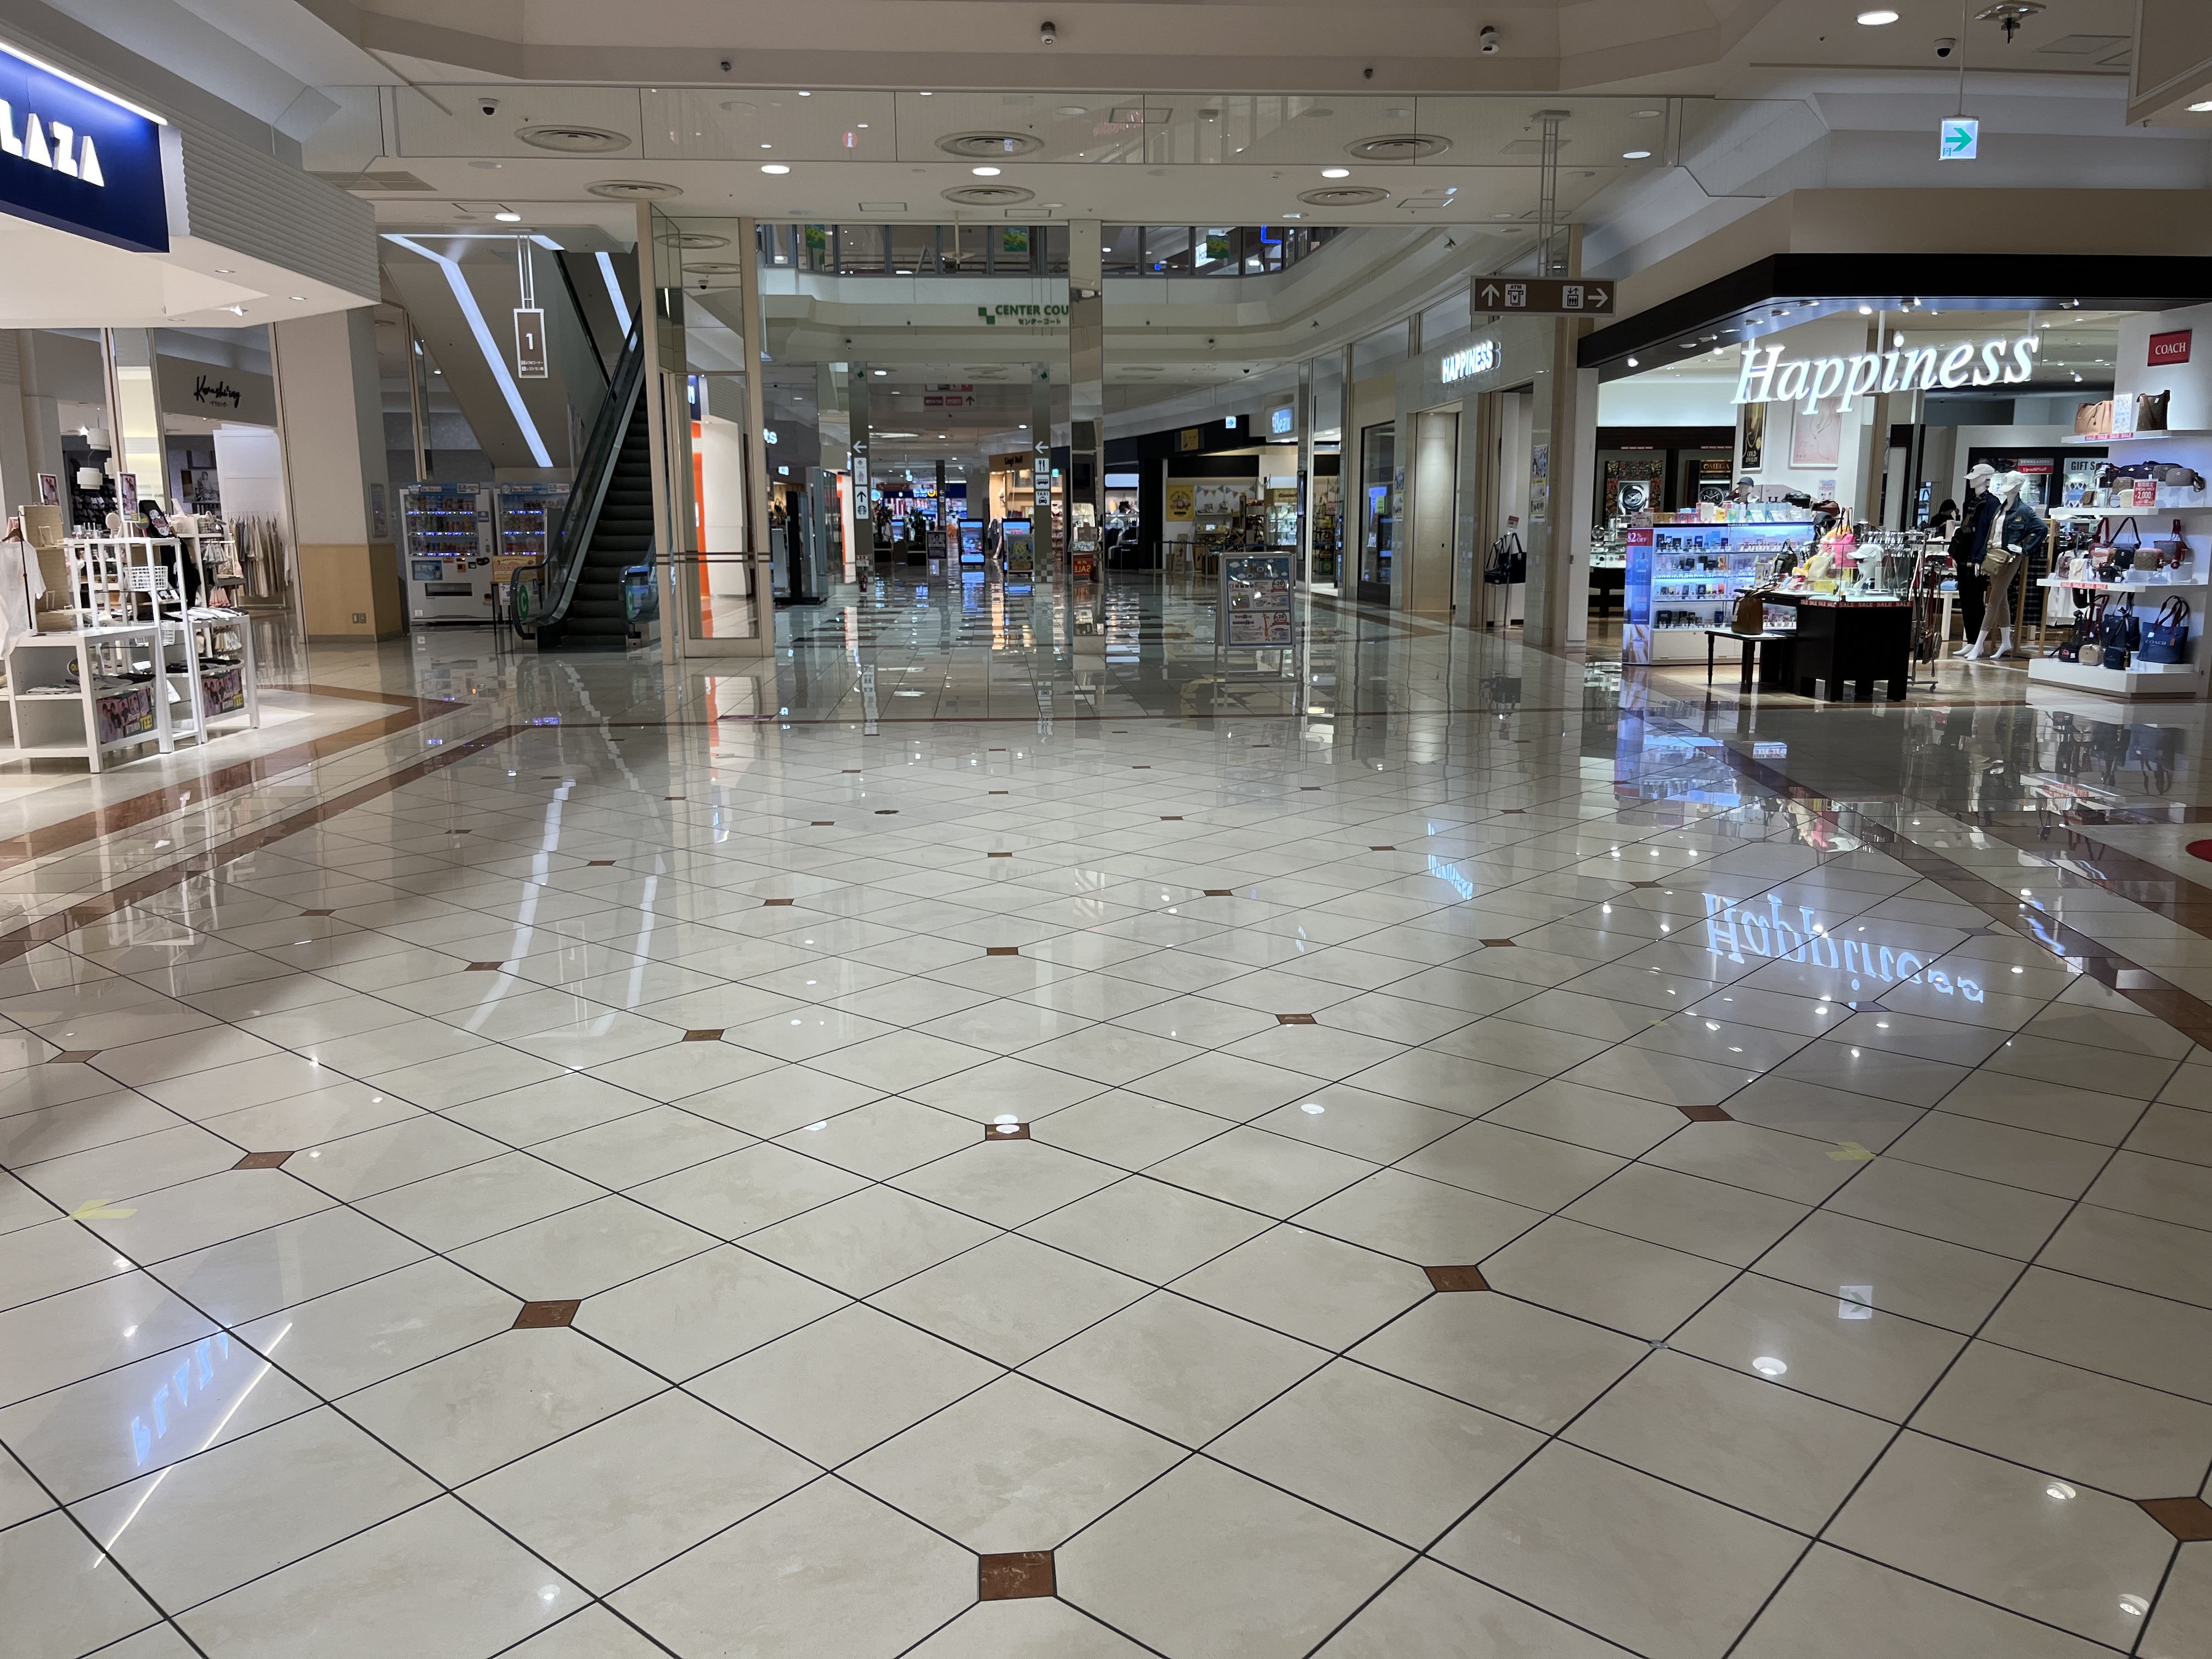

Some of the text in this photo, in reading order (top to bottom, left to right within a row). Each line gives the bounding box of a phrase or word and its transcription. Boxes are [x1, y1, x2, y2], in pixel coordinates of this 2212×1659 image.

[995, 305, 1041, 315] CENTER
[526, 333, 534, 350] 1
[2155, 342, 2186, 356] COACH
[1442, 340, 1493, 384] HAPPINESS
[1730, 331, 2040, 416] Happiness
[2071, 461, 2088, 471] GIFT
